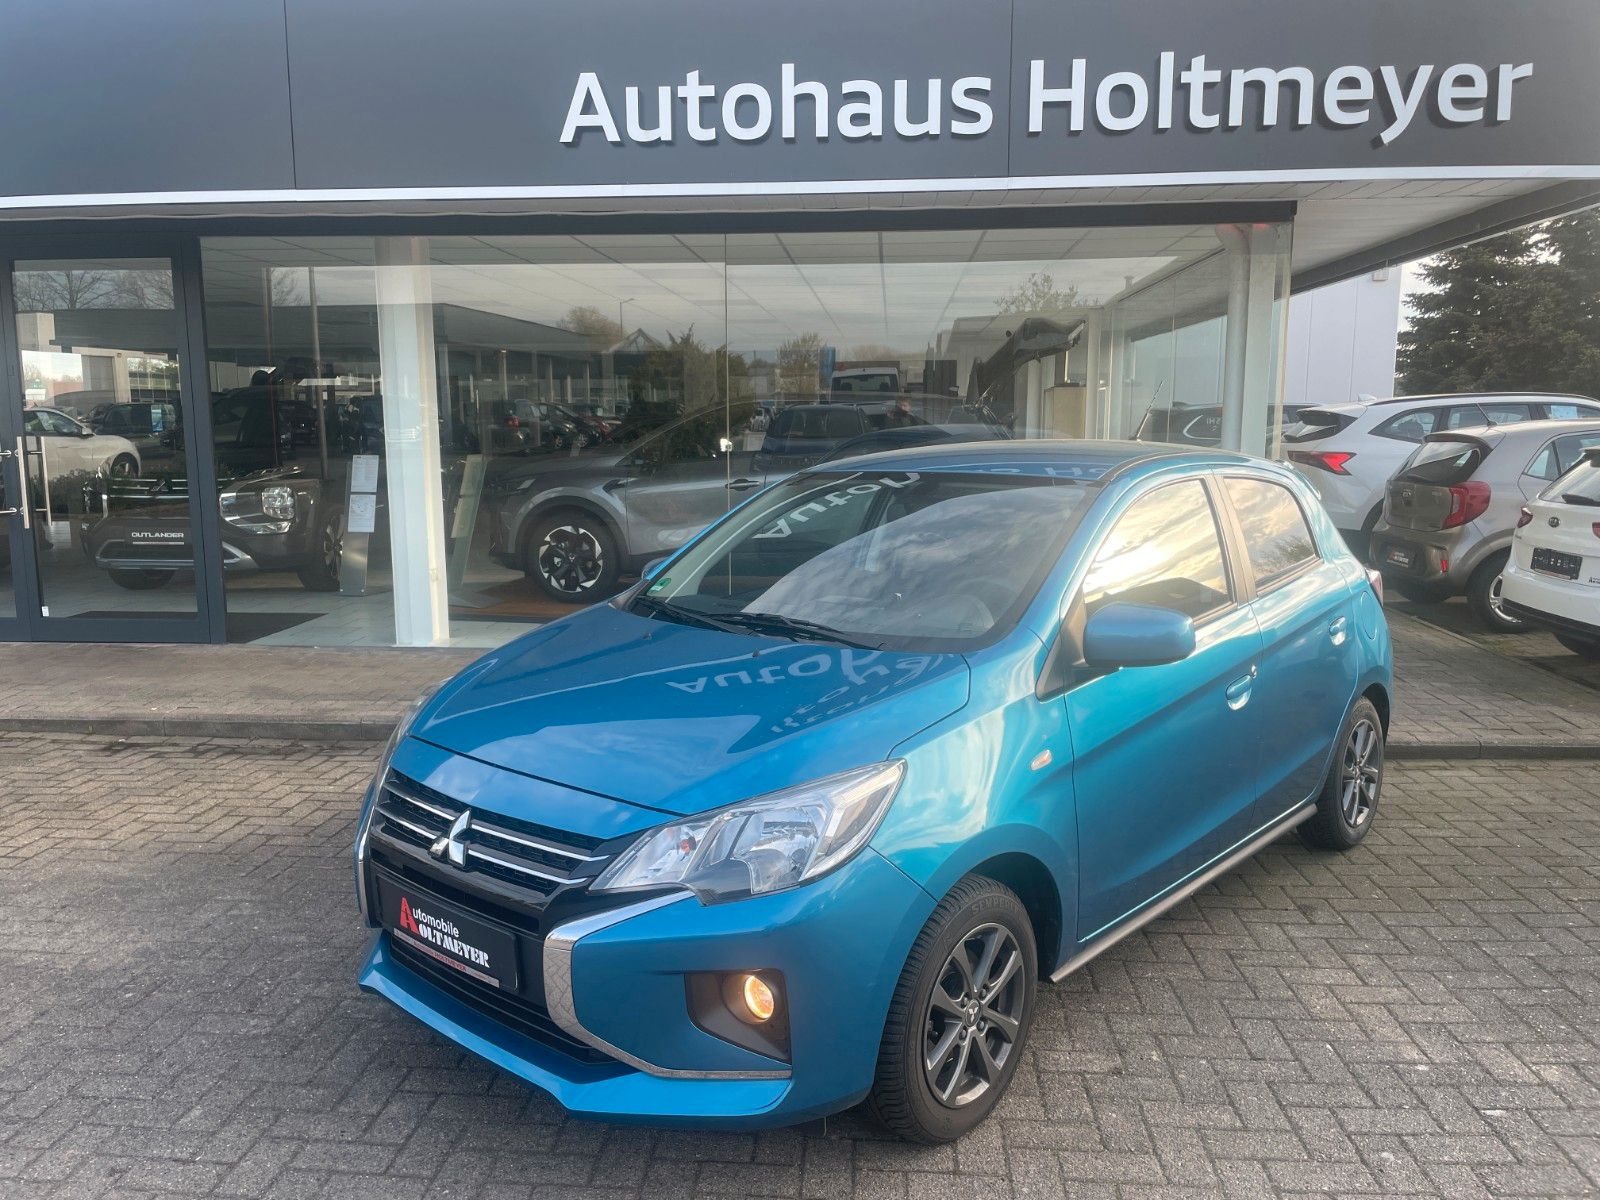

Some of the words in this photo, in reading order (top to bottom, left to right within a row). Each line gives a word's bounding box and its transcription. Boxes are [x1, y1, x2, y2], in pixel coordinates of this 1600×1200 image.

[558, 63, 994, 143] Autohaus
[1028, 51, 1534, 145] Holtmeyer
[400, 896, 460, 938] Automobile
